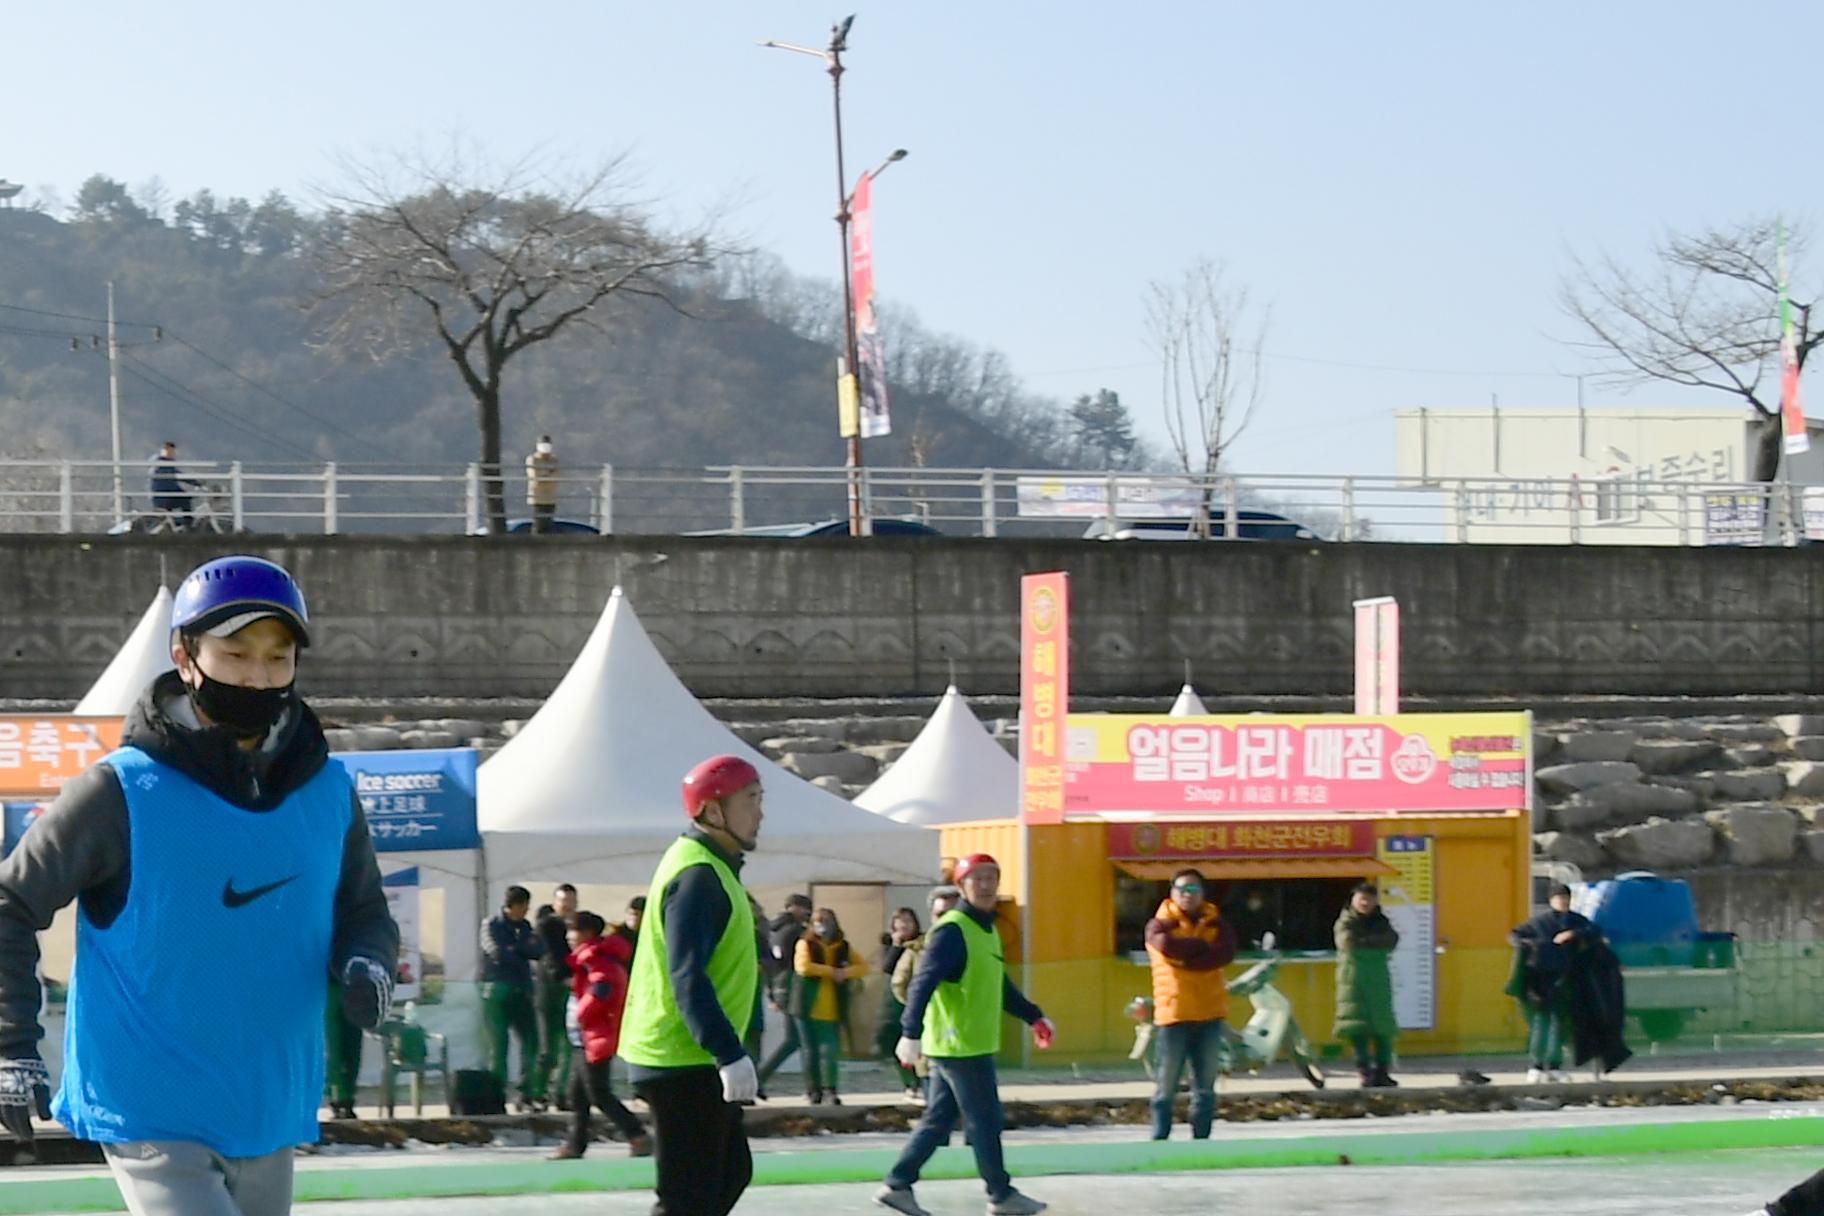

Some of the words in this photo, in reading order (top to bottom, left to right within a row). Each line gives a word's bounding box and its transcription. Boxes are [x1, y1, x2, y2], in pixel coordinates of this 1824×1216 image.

[1033, 641, 1056, 756] 해병대
[1129, 726, 1293, 781] 얼음나라
[1304, 727, 1384, 781] 매점
[357, 771, 383, 791] Ice
[384, 772, 443, 790] soccer
[1184, 784, 1225, 804] Shop
[1166, 826, 1227, 851] 해병대
